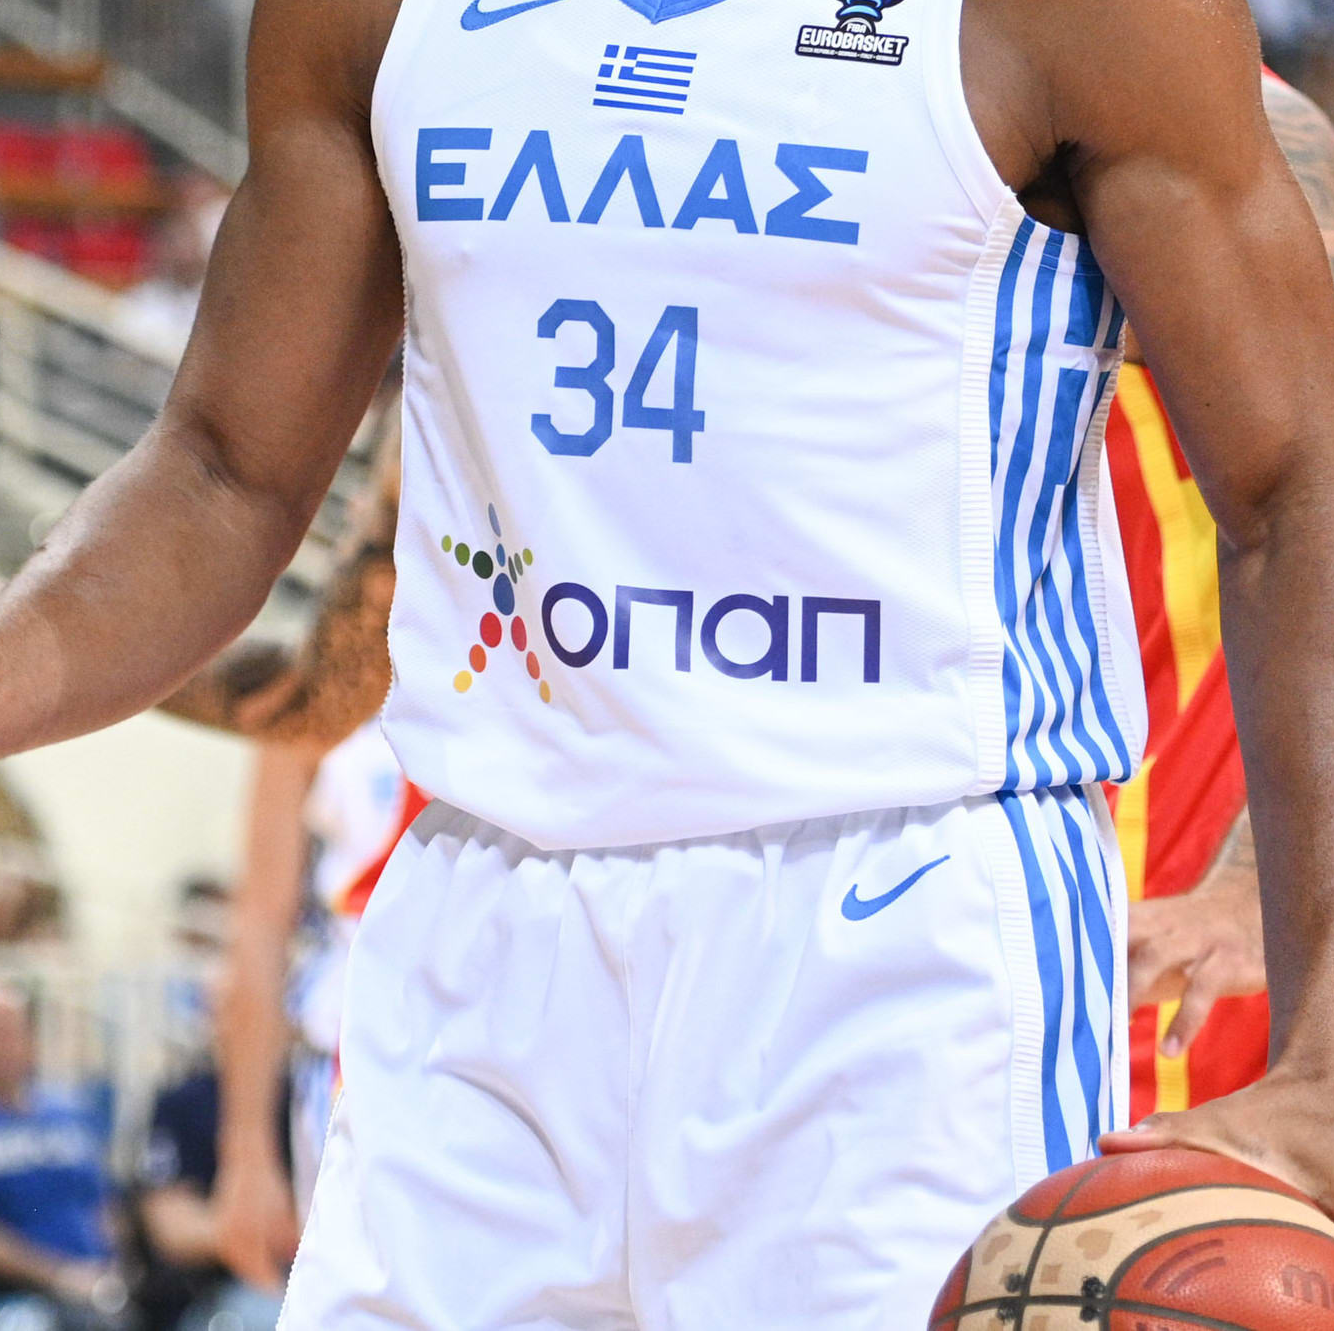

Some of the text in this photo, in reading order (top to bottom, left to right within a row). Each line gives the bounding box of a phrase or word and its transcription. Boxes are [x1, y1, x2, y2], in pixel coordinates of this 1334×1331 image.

[799, 27, 907, 55] EUROBASKET
[415, 127, 869, 246] ΕΛΛΑΣ
[531, 298, 706, 464] 34
